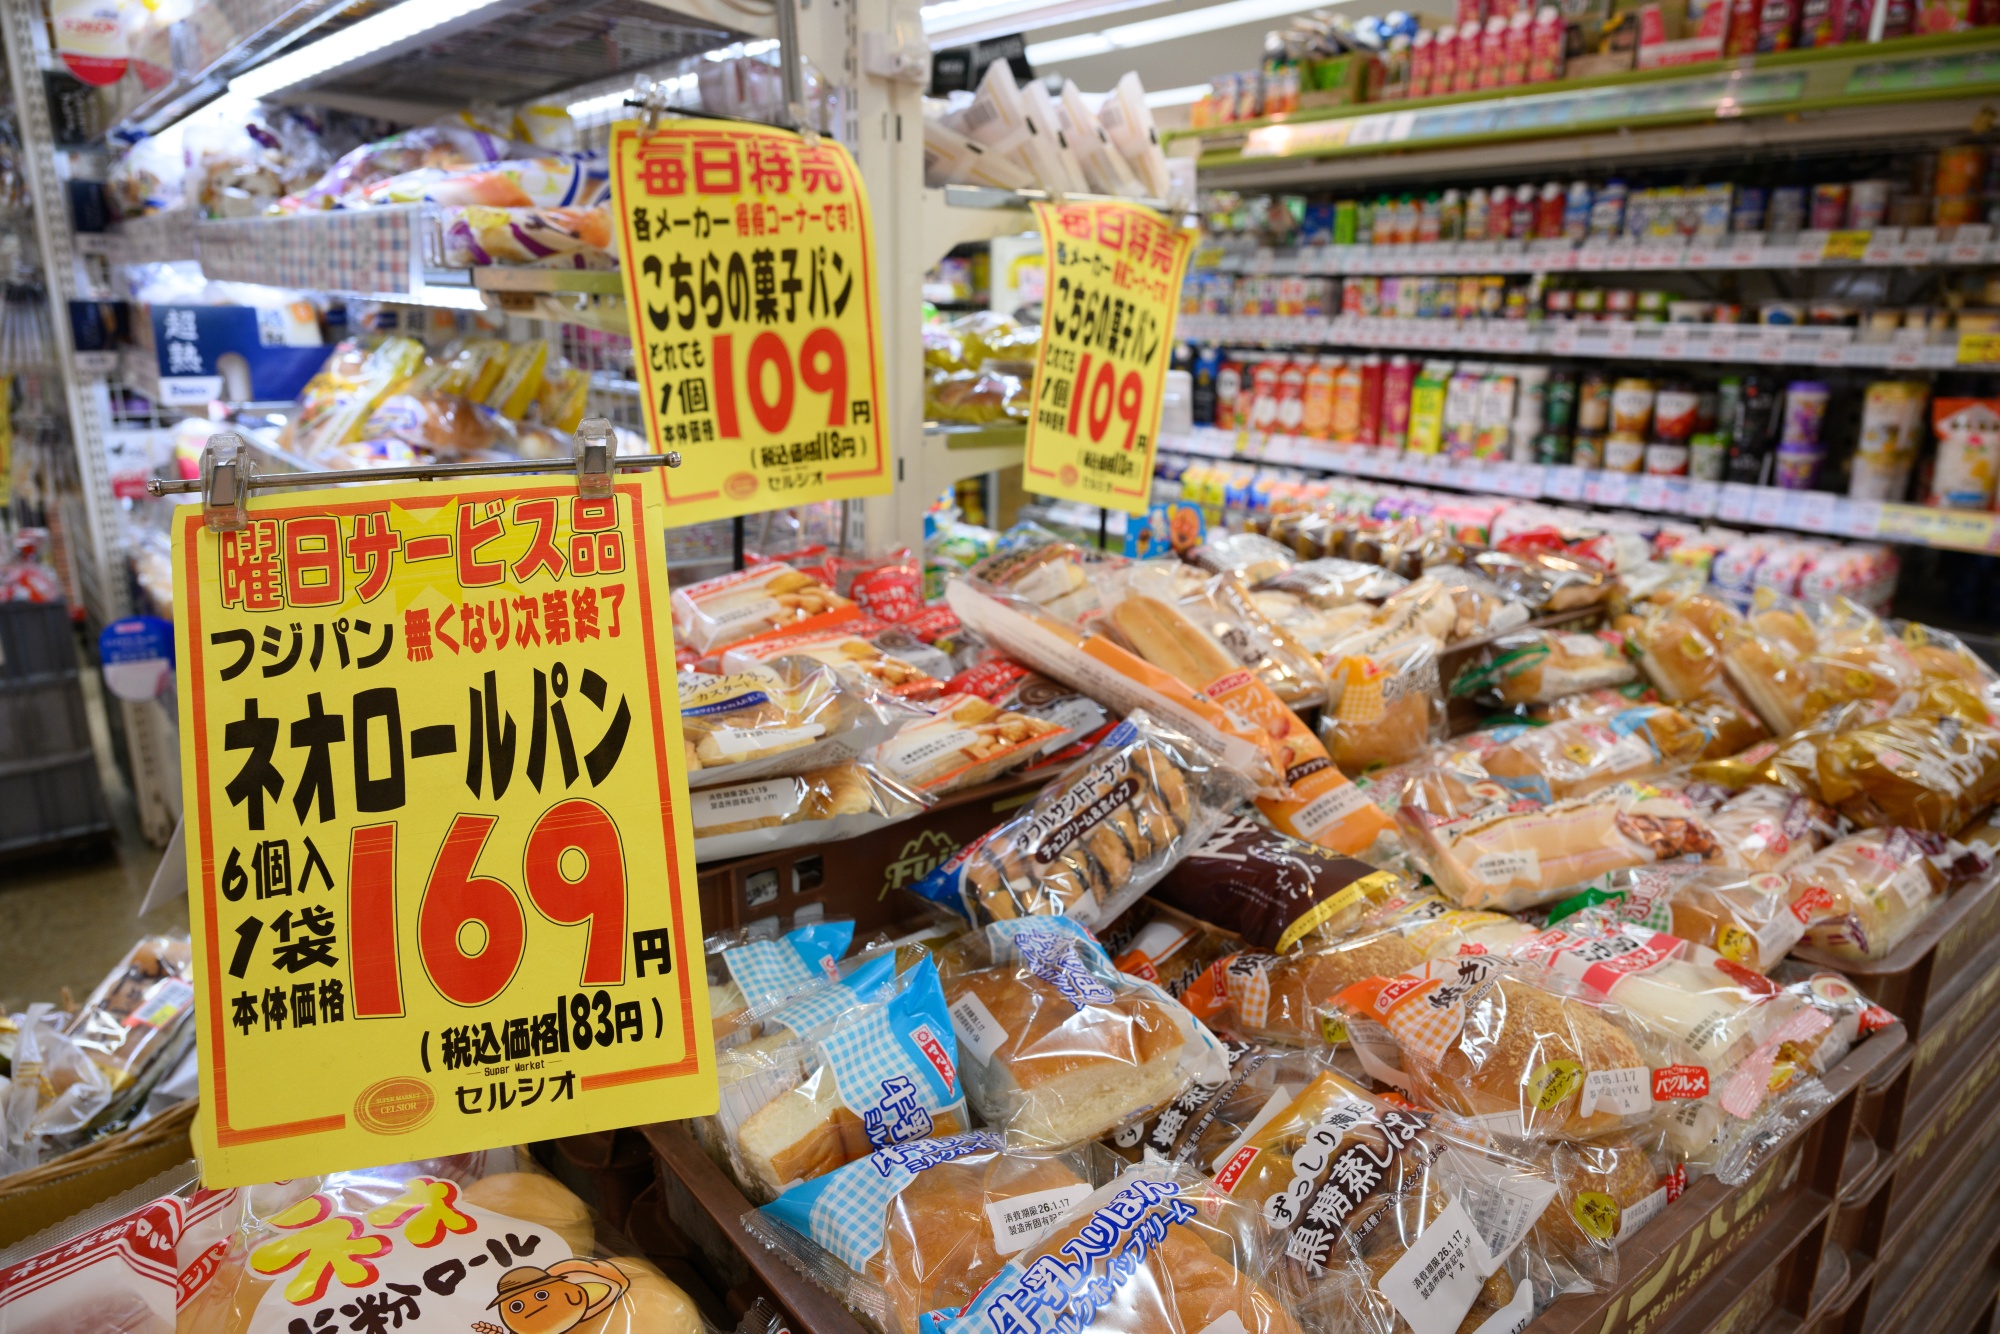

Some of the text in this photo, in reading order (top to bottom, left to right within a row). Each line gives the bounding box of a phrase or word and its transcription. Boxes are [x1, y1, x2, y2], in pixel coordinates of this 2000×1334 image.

[636, 139, 844, 197] 毎日特売
[633, 206, 730, 242] 各メーカー
[642, 246, 854, 332] こちらの菓子パン
[649, 340, 705, 372] どれでも
[660, 326, 871, 440] 1個 109 円
[661, 419, 715, 447] 本体価格
[1067, 353, 1144, 454] 109
[768, 471, 823, 492] セルシオ
[218, 494, 627, 613] 曜日サービス品
[210, 617, 393, 681] フジパン
[404, 583, 626, 662] 無くなり次第終了
[224, 661, 632, 831] ネオロールパン
[1015, 752, 1129, 851] ダブルサンドドーナツ
[1041, 780, 1133, 860] チョコクリーム&ホイップ
[222, 836, 335, 902] 6個入
[228, 799, 673, 1020] 1袋 169 円
[231, 978, 346, 1036] 本体価格
[455, 1070, 577, 1115] セルシオ
[484, 1060, 546, 1078] Super Market
[380, 1101, 417, 1115] CELSIOR
[1272, 1101, 1375, 1224] ずっしり満足
[249, 1178, 478, 1306] ネオ
[1412, 1229, 1463, 1290] 消費期限26.1.17
[1420, 1246, 1464, 1300] 製造所固有記号
